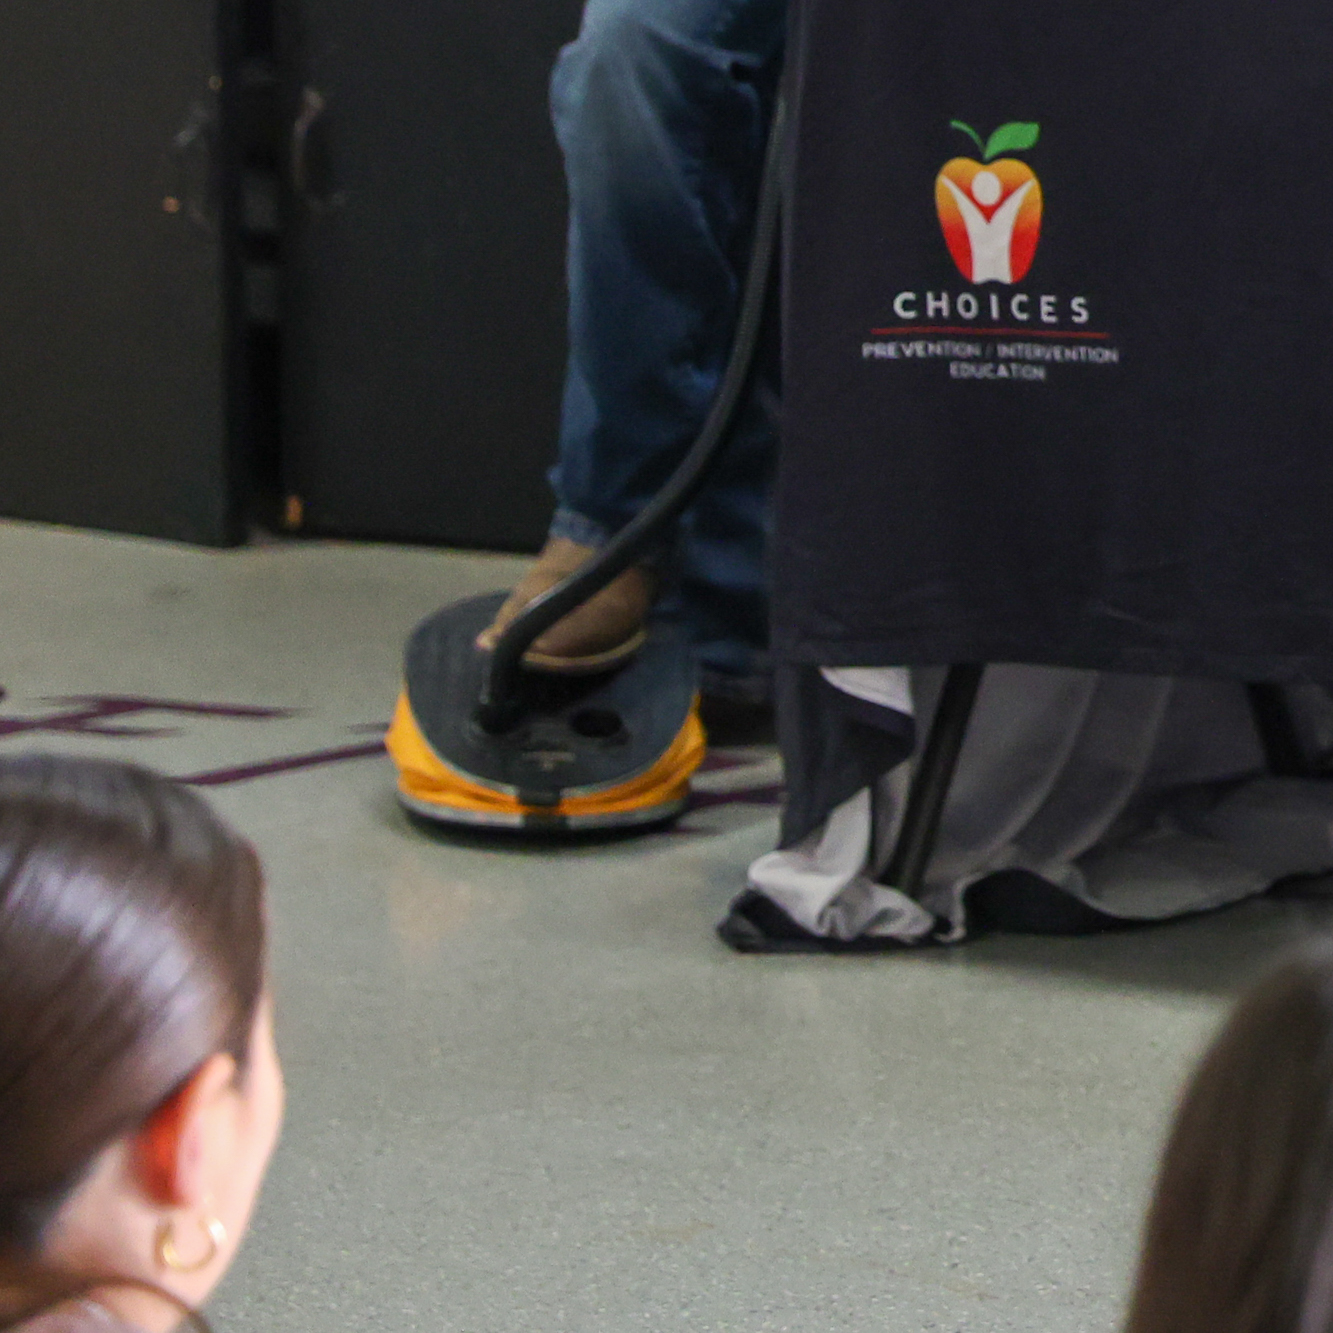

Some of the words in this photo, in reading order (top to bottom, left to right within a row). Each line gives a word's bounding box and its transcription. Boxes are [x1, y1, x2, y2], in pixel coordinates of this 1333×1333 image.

[893, 291, 1090, 323] CHOICES
[862, 341, 982, 359] PREVENTION
[997, 342, 1119, 363] INTERVENTION
[950, 363, 1046, 381] EDUCATION
